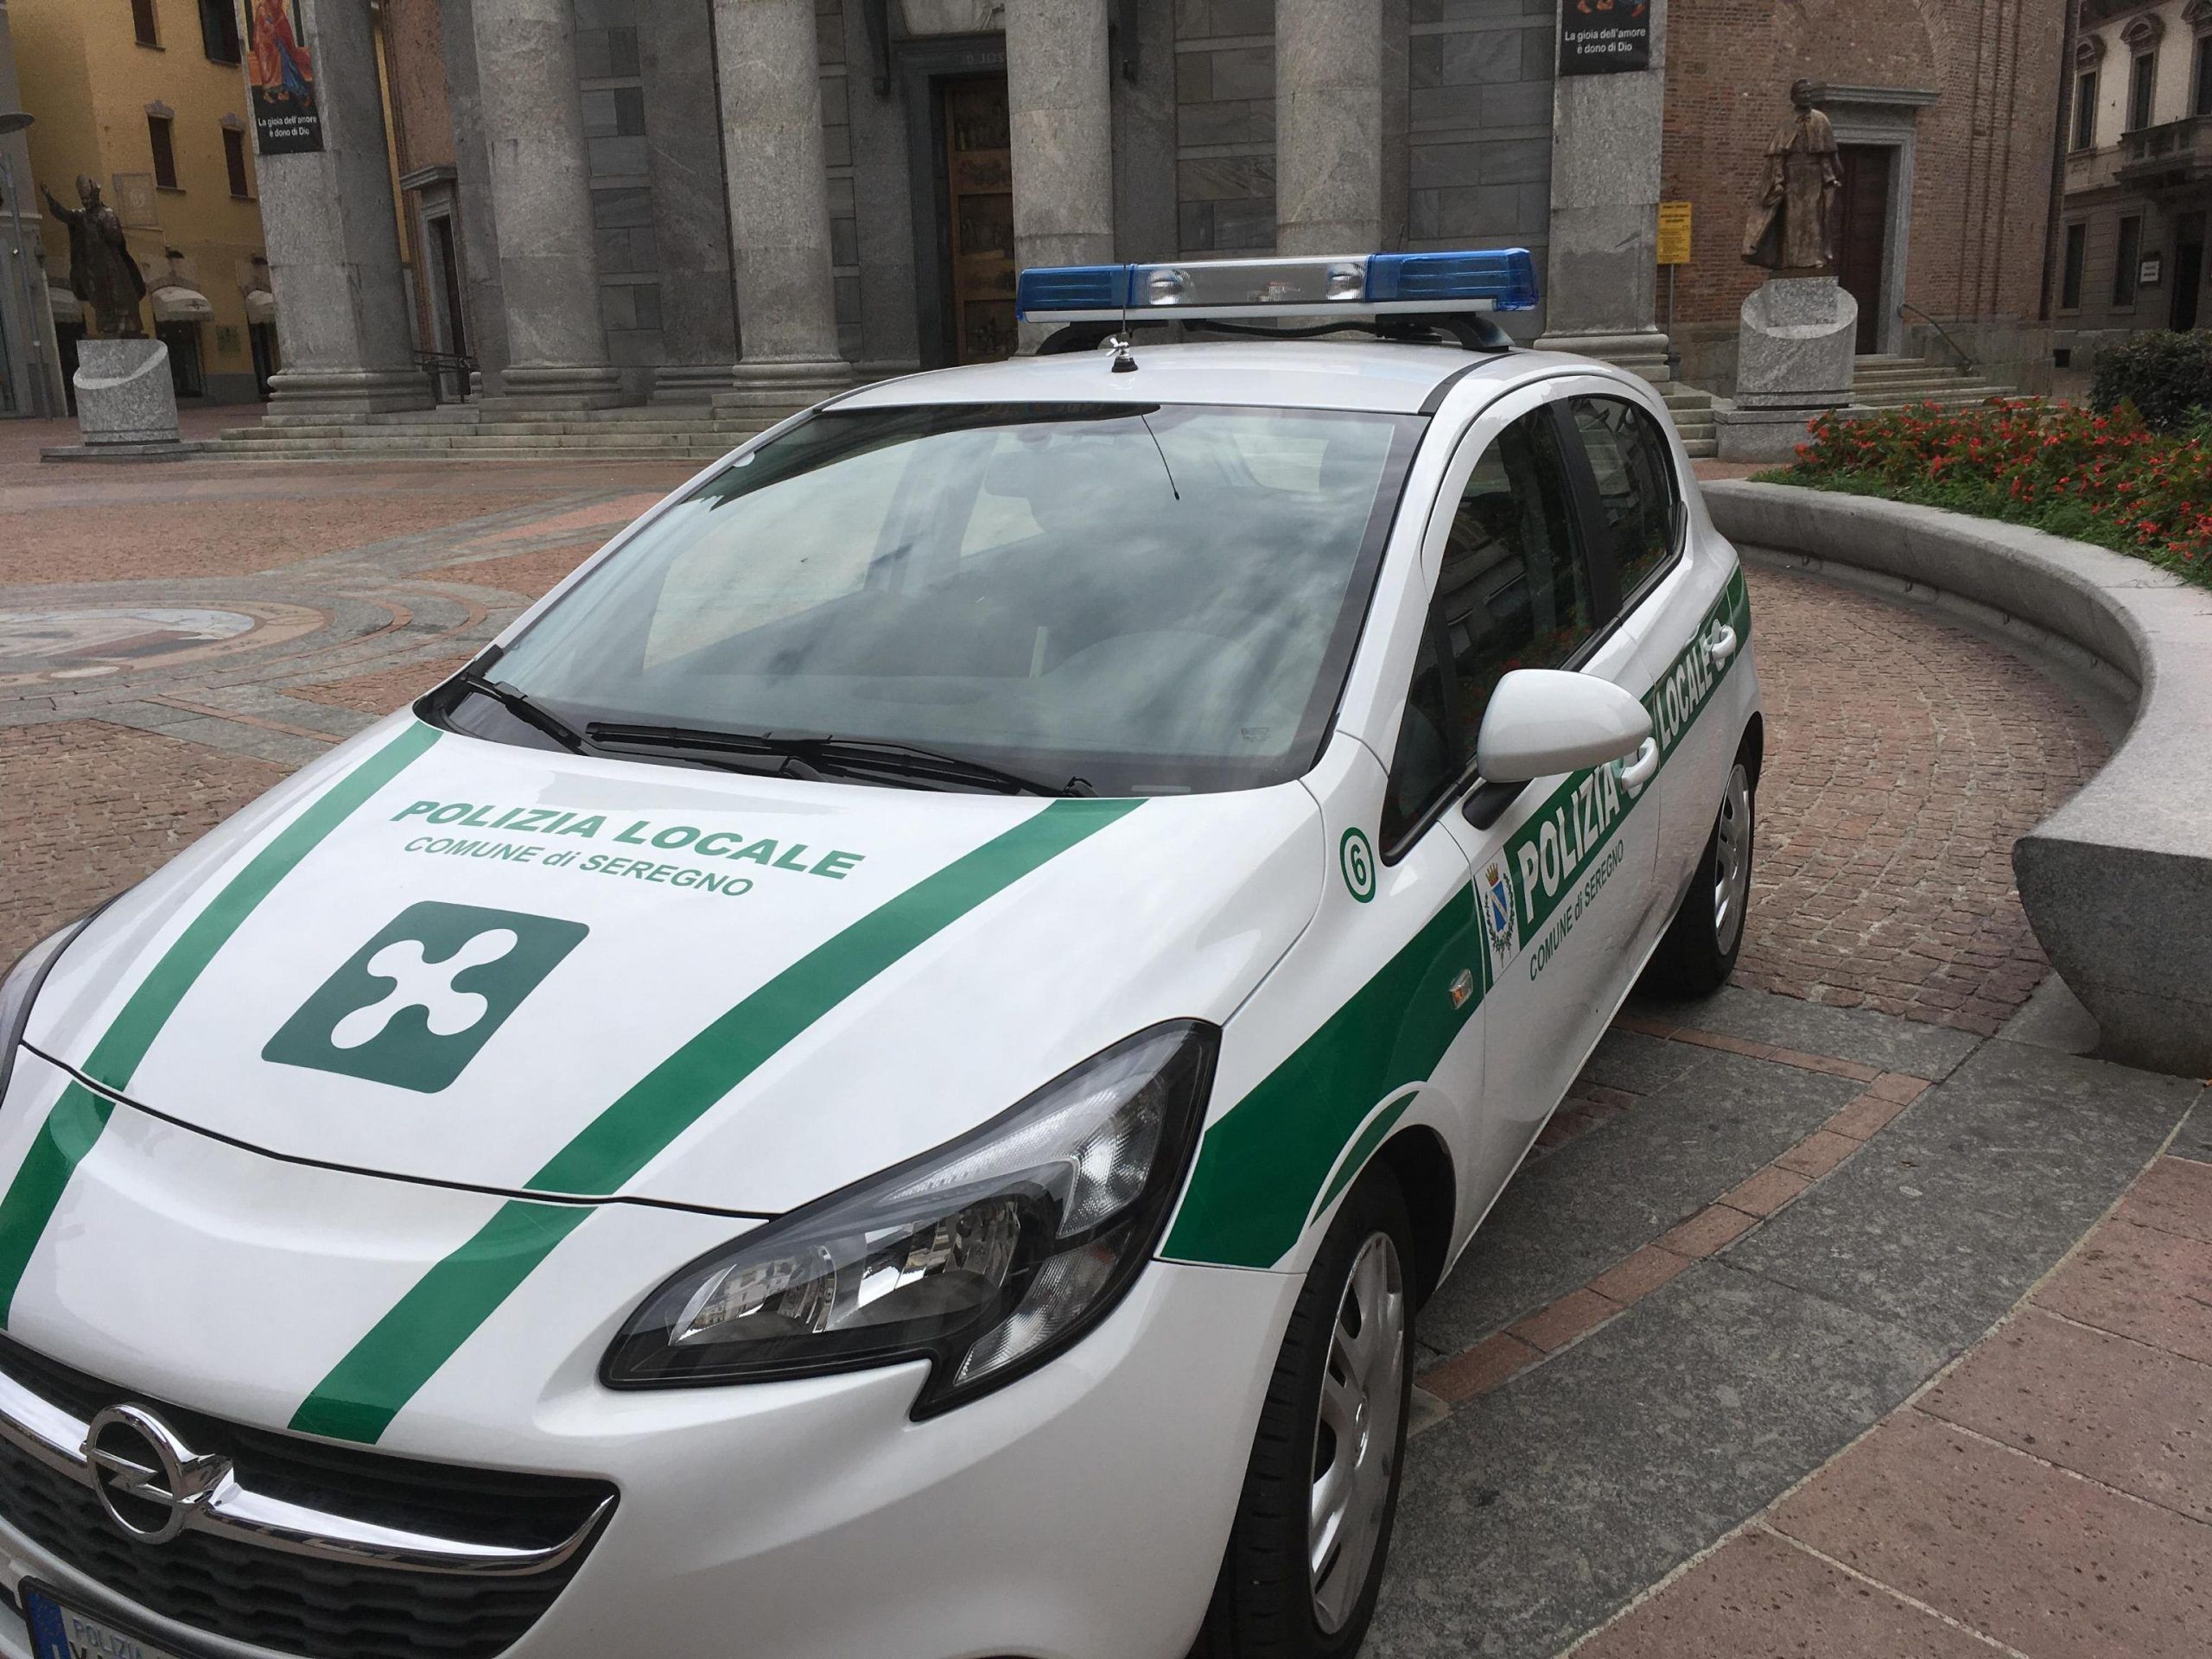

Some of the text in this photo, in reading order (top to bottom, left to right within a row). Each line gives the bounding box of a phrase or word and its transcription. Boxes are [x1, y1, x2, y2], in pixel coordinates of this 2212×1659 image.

[1565, 28, 1646, 42] La gioia dell'amore
[1584, 44, 1606, 54] dono
[1608, 42, 1616, 52] di
[1618, 42, 1632, 52] Dio
[268, 118, 283, 128] gioia
[284, 116, 317, 124] dell'amore
[275, 128, 290, 137] dono
[1517, 632, 1713, 925] POLIZIA LOCALE
[389, 800, 867, 880] POLIZIA LOCALE
[404, 836, 753, 896] COMUNE di SEREGNO
[1351, 843, 1366, 887] 6
[1529, 838, 1624, 982] COMUNE di SEREGNO
